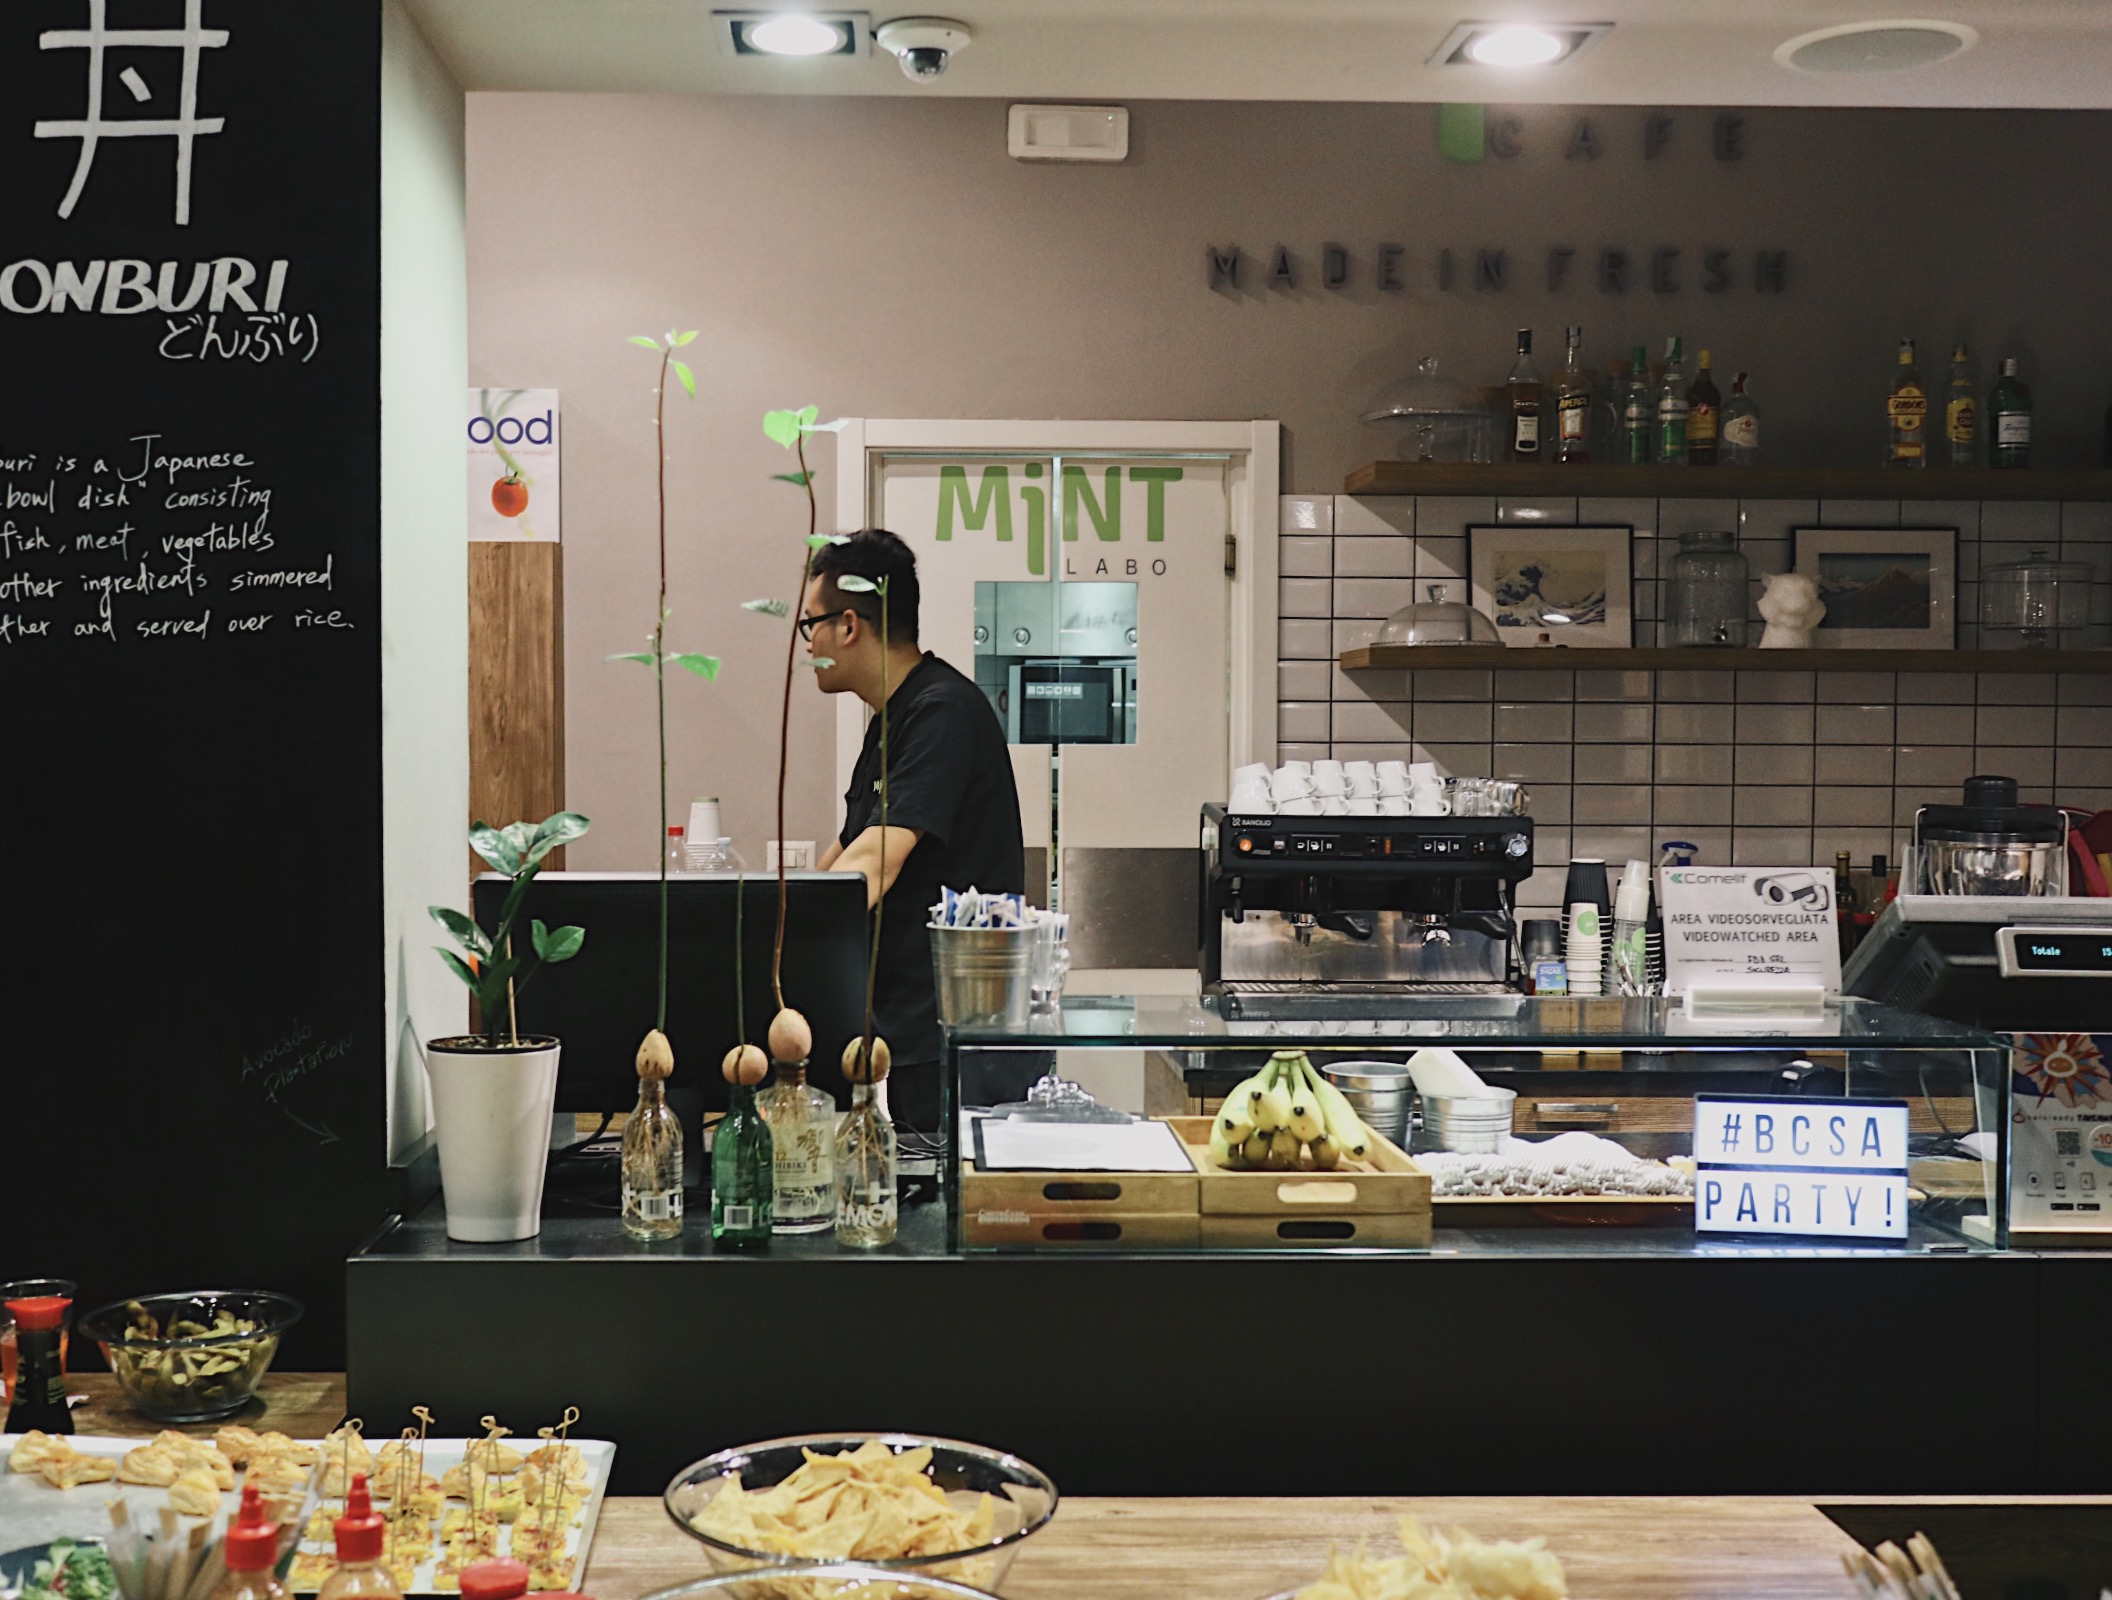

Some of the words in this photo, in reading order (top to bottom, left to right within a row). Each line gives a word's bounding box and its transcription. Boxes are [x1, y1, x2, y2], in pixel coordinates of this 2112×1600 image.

[0, 258, 289, 315] ONBURI
[1206, 241, 1406, 292] MADE
[1438, 247, 1505, 292] IN
[1546, 247, 1789, 295] FRESH
[159, 312, 320, 363] どんぶり
[1558, 394, 1590, 411] APEROL
[56, 456, 77, 473] is
[93, 458, 109, 473] a
[117, 434, 255, 484] Japanese
[5, 479, 54, 513] bowl
[165, 475, 272, 535] consisting
[162, 522, 275, 563] vegetables
[0, 572, 63, 603] other
[83, 559, 207, 619] ingredients
[230, 554, 333, 592] simmered
[1066, 558, 1166, 575] LABO
[74, 614, 117, 642] and
[137, 609, 210, 640] served
[228, 613, 273, 633] over
[295, 608, 355, 629] rice.
[1241, 818, 1272, 827] RANCILIO
[1671, 912, 1702, 926] AREA
[1707, 912, 1829, 926] VIDEOSORVEGLIATA
[1683, 930, 1781, 944] VIDEOWATCHED
[1787, 931, 1818, 944] AREA
[2031, 945, 2062, 957] Totale
[240, 1017, 312, 1085] Avocado
[1721, 1114, 1882, 1158] #BCSA
[775, 1161, 807, 1169] HIBIKI
[1705, 1181, 1892, 1228] PARTY!
